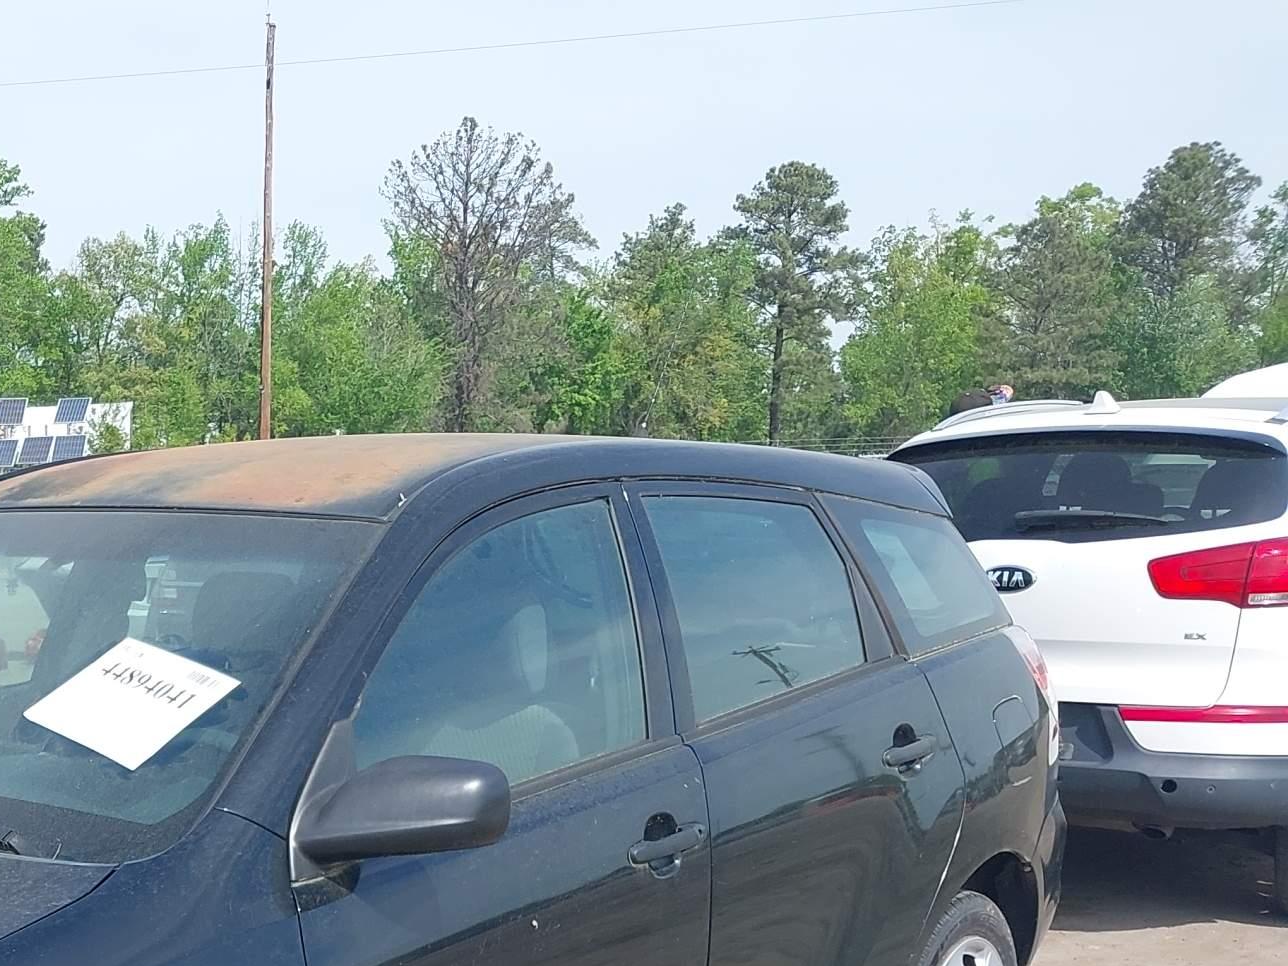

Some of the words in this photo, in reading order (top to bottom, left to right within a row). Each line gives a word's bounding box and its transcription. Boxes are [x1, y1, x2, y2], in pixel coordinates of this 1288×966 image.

[987, 570, 1025, 587] KIA
[1184, 632, 1207, 640] EX
[101, 661, 197, 709] 44894041
